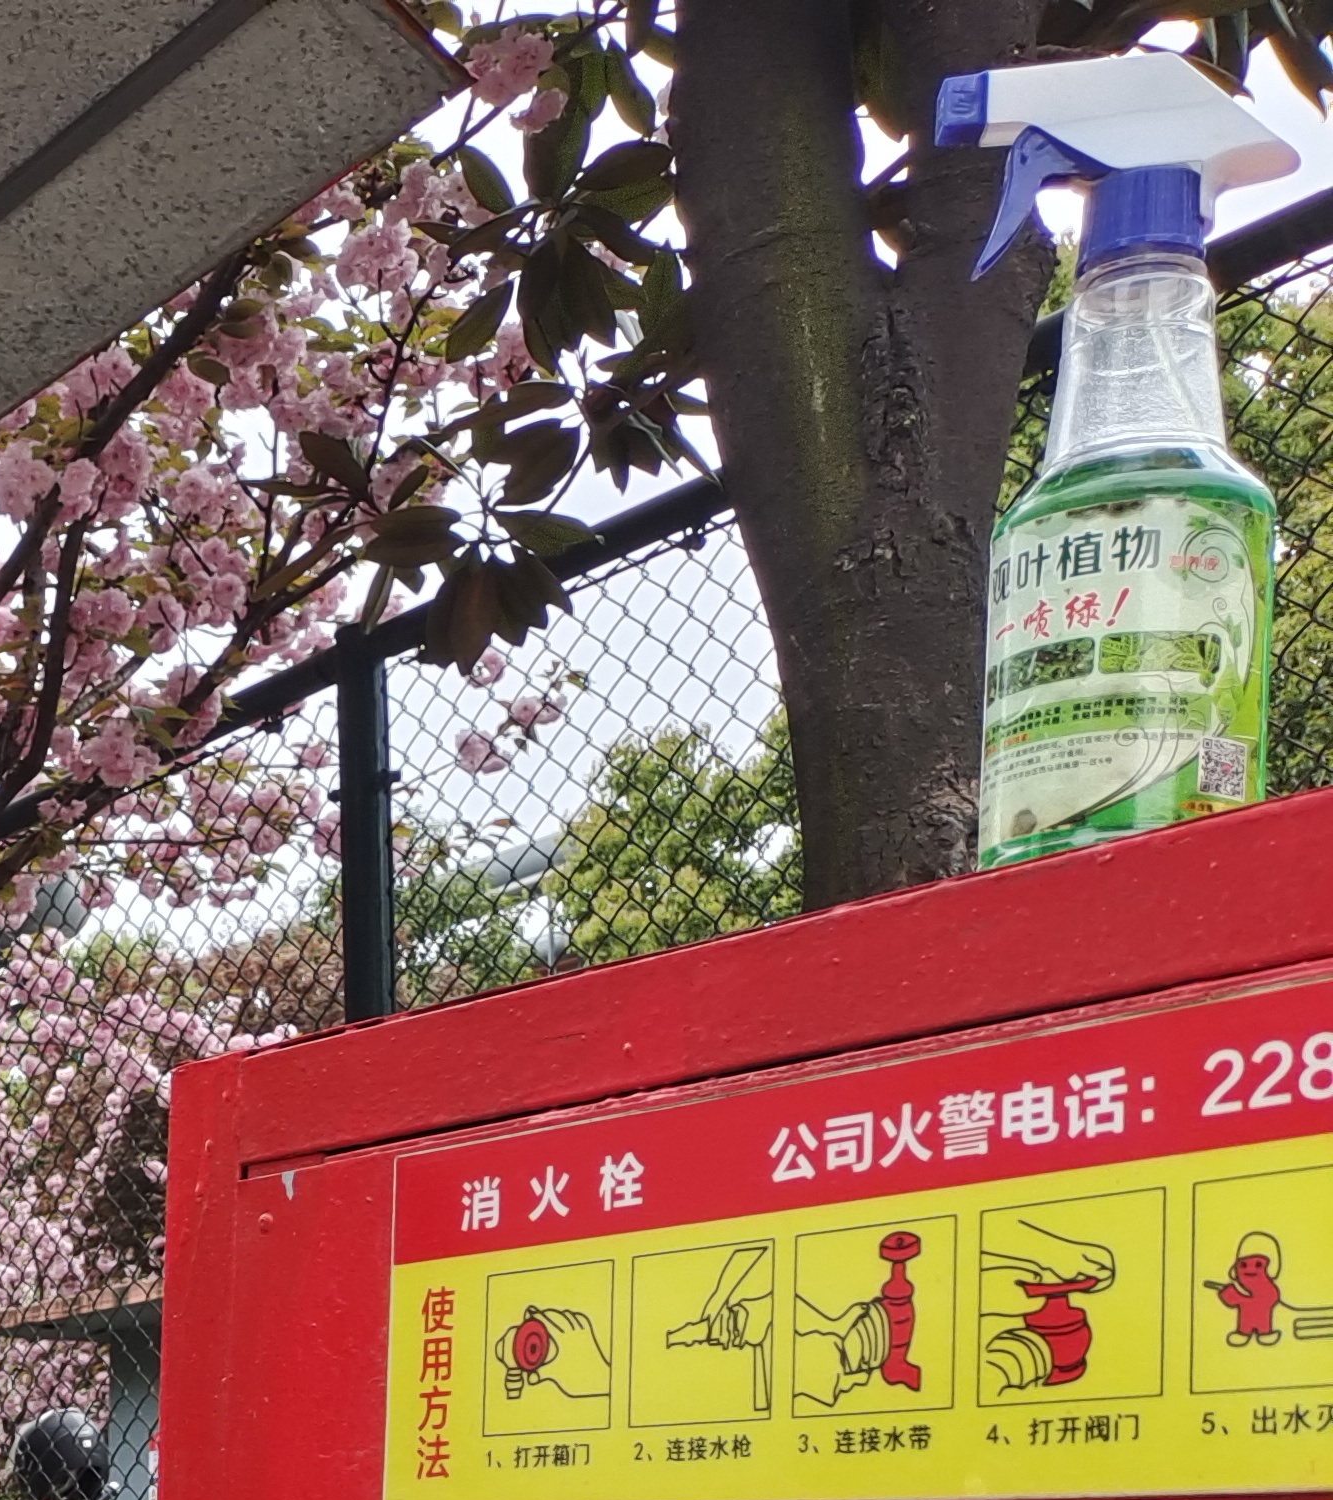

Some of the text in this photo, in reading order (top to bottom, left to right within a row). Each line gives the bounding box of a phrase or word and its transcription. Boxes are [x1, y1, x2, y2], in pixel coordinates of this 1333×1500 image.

[992, 525, 1162, 607] 观叶植物
[460, 1151, 644, 1231] 消火栓
[769, 1067, 1155, 1183] 公司火警电话：
[416, 1286, 455, 1479] 使用方法
[798, 1424, 932, 1455] 3、连接水带
[986, 1413, 1140, 1446] 4、打开阀门
[486, 1443, 590, 1468] 1、打开箱门
[633, 1435, 752, 1463] 2、连接水枪
